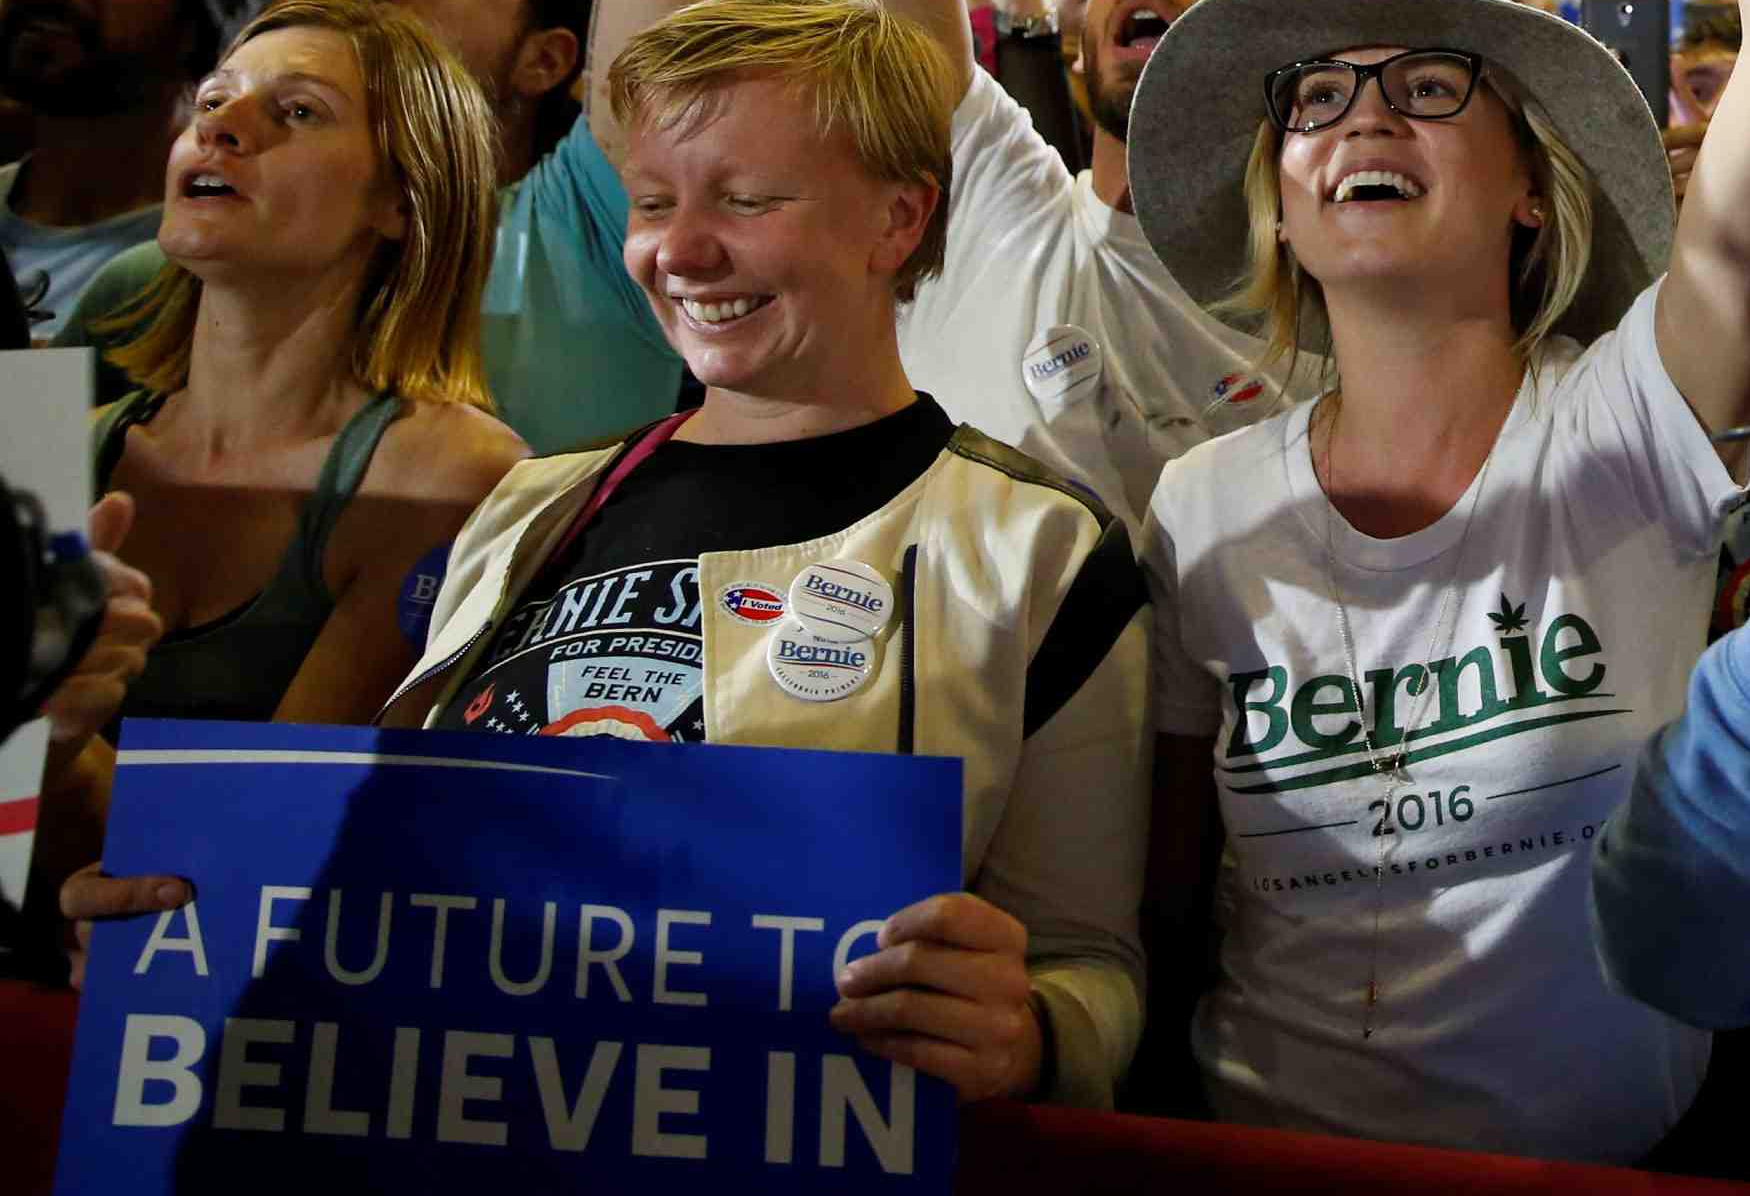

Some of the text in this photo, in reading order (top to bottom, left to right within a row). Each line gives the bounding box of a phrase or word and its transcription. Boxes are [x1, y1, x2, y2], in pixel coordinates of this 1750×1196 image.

[1029, 340, 1091, 381] Bernie
[751, 600, 783, 611] Voted
[805, 574, 883, 612] Bernie
[550, 636, 703, 664] FOR PRESID
[779, 640, 866, 667] Bernie
[581, 665, 687, 685] FEEL THE
[808, 669, 830, 680] 2016
[1225, 593, 1607, 757] Bernie
[584, 682, 663, 703] BERN
[1367, 785, 1475, 838] 2016
[133, 895, 209, 977] A
[251, 884, 712, 1006] FUTURE
[113, 1013, 916, 1176] BELIEVE IN
